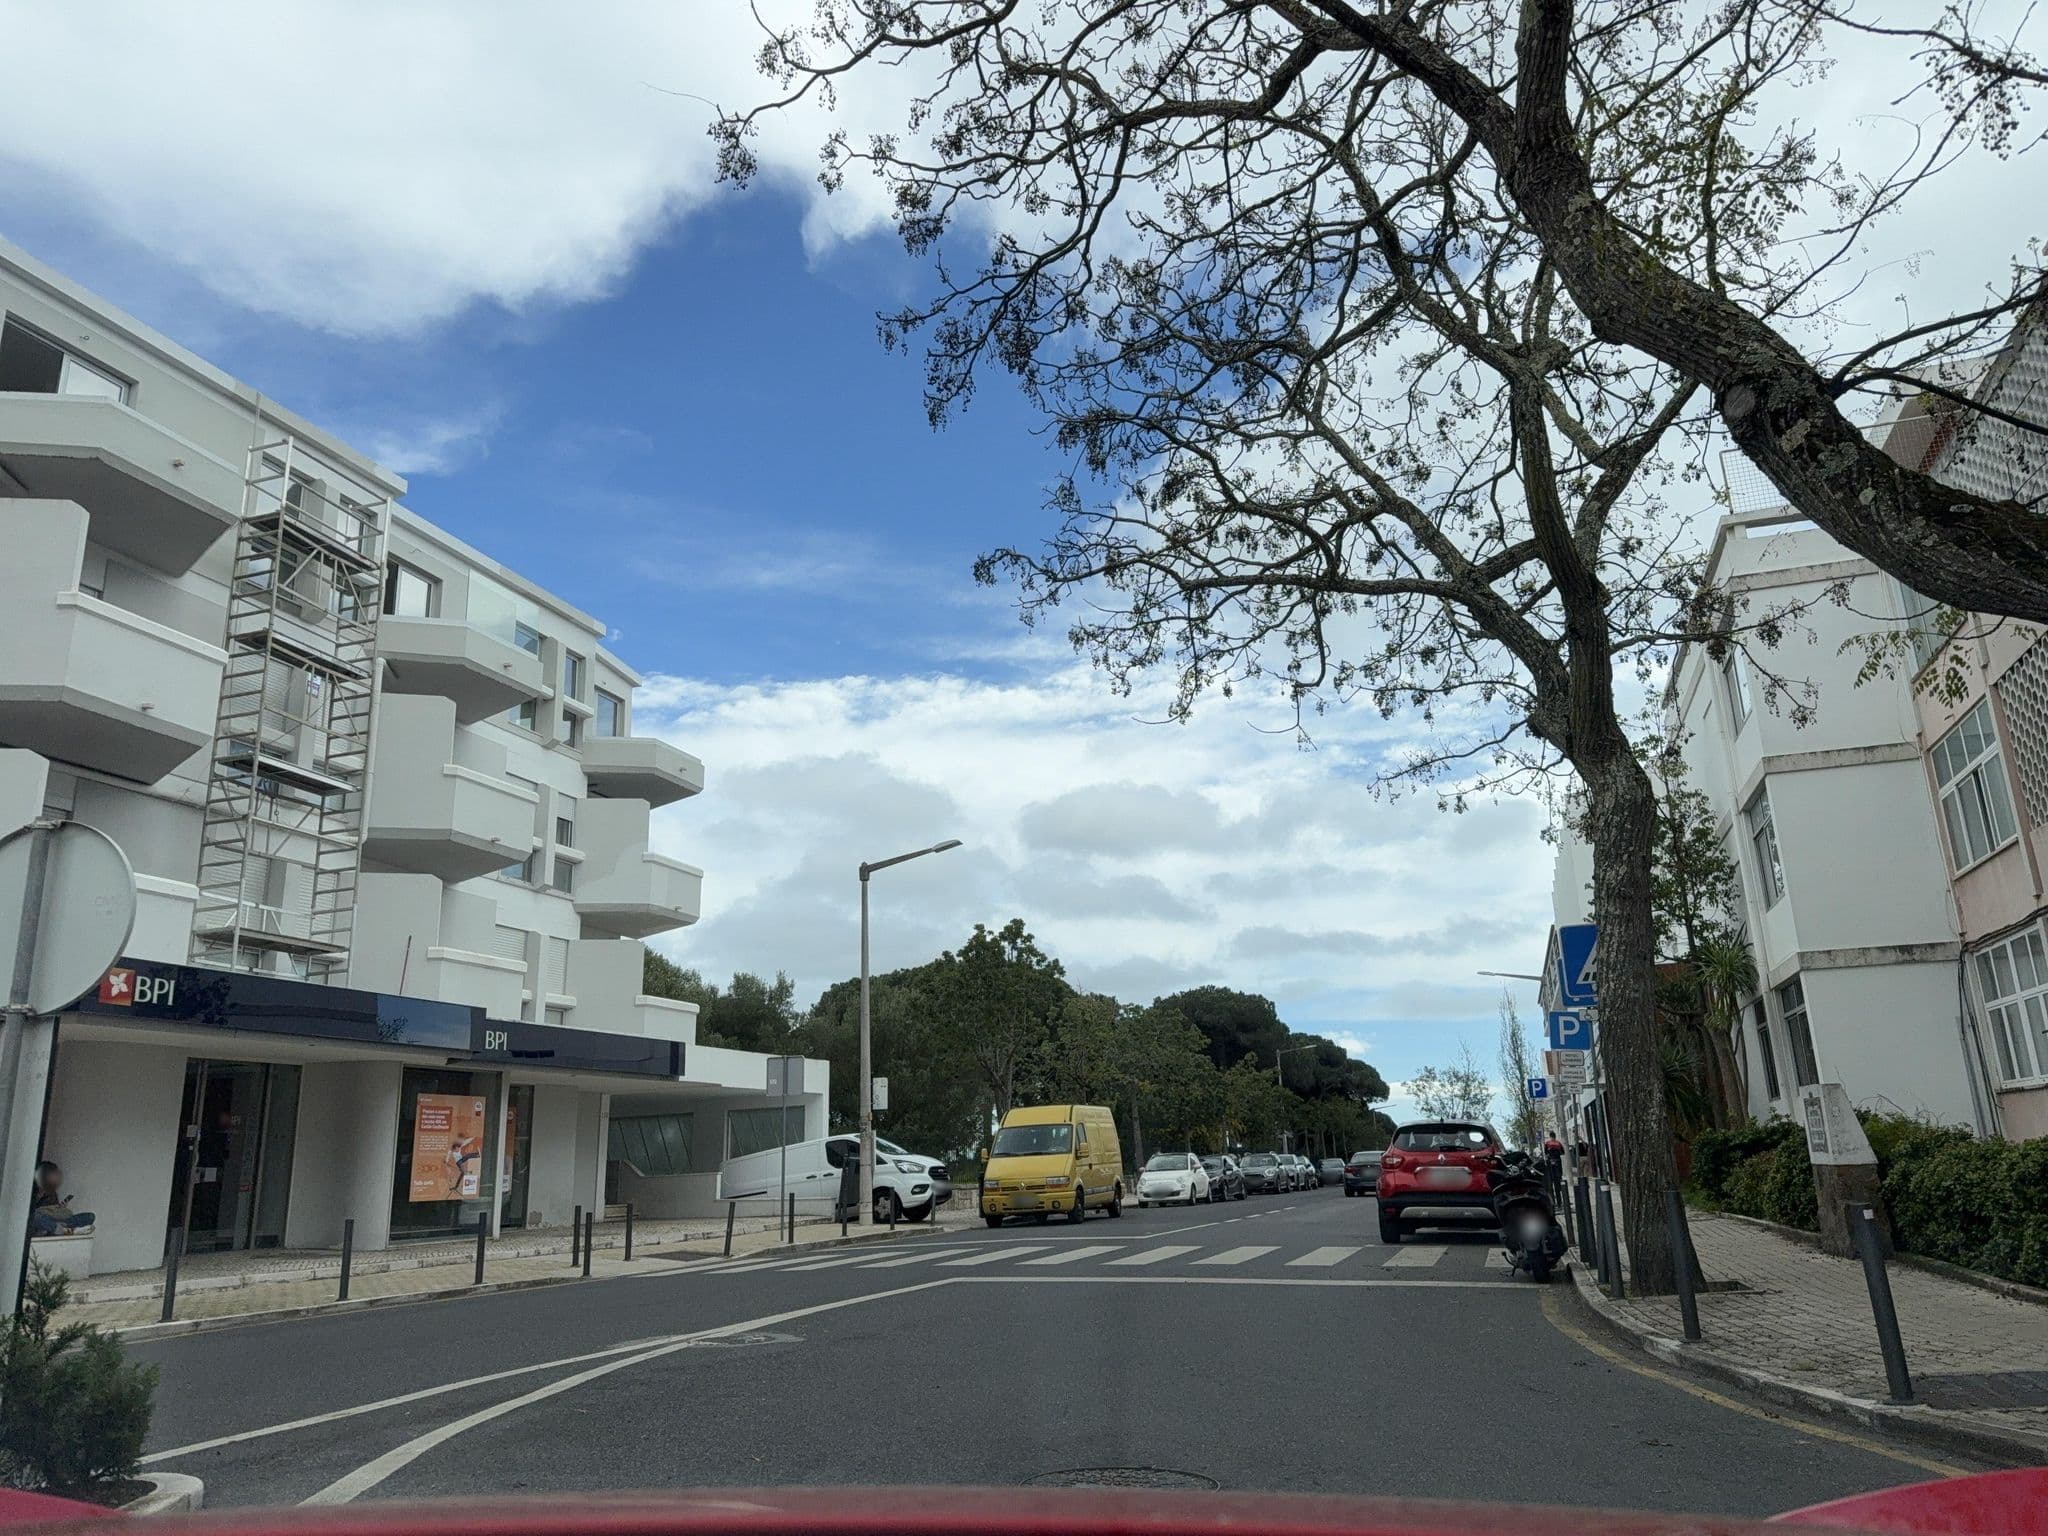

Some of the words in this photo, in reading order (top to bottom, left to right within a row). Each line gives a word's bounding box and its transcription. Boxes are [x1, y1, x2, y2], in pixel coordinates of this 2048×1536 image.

[134, 975, 175, 1006] BPI
[484, 1030, 508, 1051] BPI
[1558, 1015, 1580, 1045] P
[1531, 1080, 1543, 1097] P
